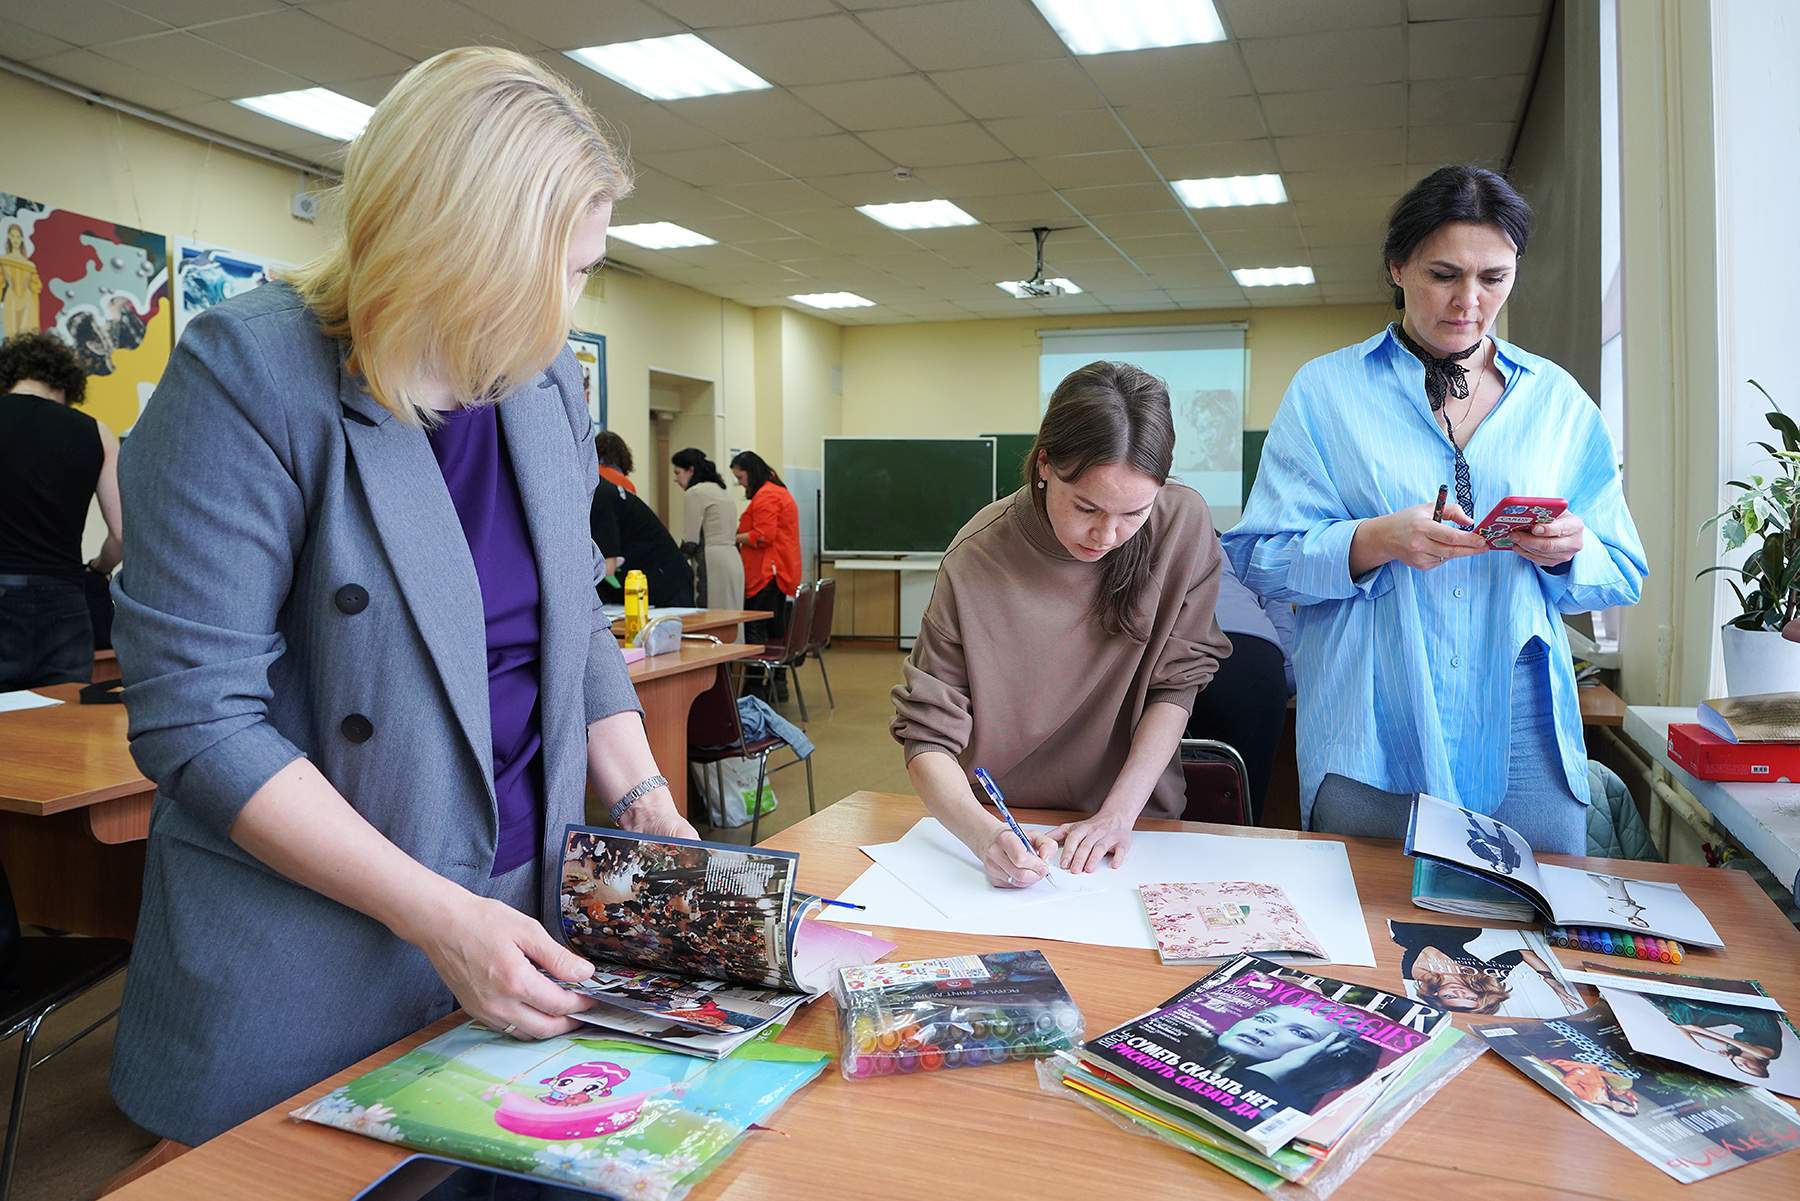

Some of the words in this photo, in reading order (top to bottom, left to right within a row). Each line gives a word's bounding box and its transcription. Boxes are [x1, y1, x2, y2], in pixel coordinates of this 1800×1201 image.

[1109, 1042, 1177, 1079] РИСКНУТЬ
[1174, 1075, 1236, 1107] СКАЗАТЬ
[1229, 1101, 1261, 1120] ДА
[1126, 1037, 1181, 1066] СУМЕТЬ
[1178, 1062, 1243, 1095] СКАЗАТЬ
[1240, 1089, 1278, 1110] НЕТ
